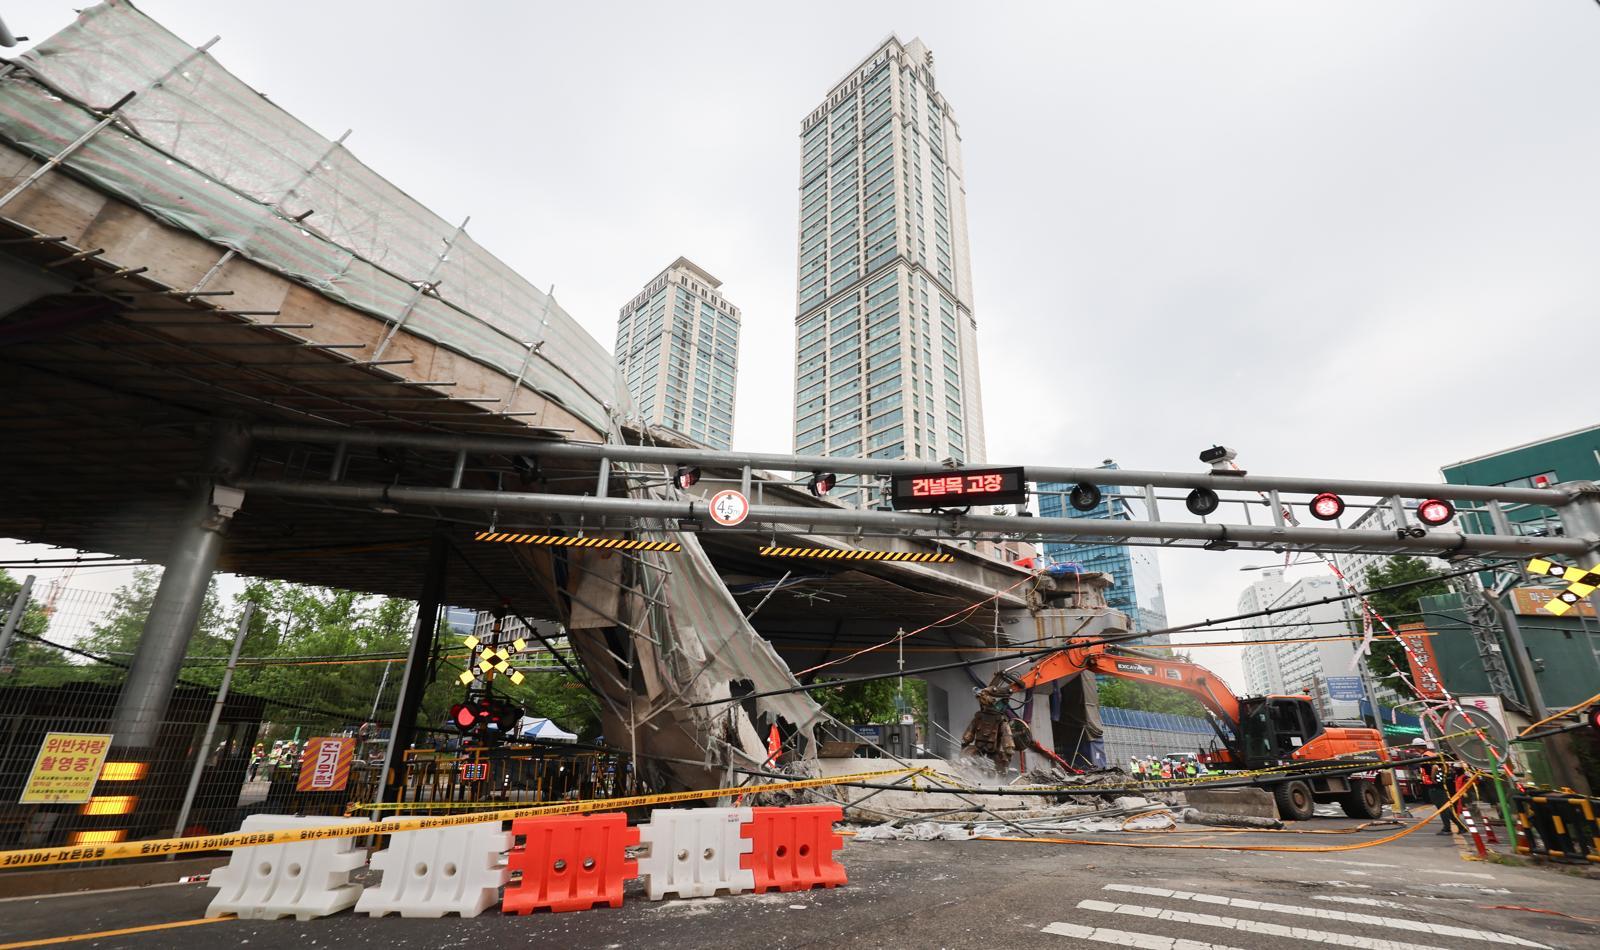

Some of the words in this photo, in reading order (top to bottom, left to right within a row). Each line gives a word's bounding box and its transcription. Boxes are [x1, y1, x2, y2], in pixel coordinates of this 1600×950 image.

[912, 476, 963, 496] 건널목
[966, 474, 1003, 493] 고장
[46, 738, 106, 754] 위반차량
[314, 742, 340, 785] 전기위험
